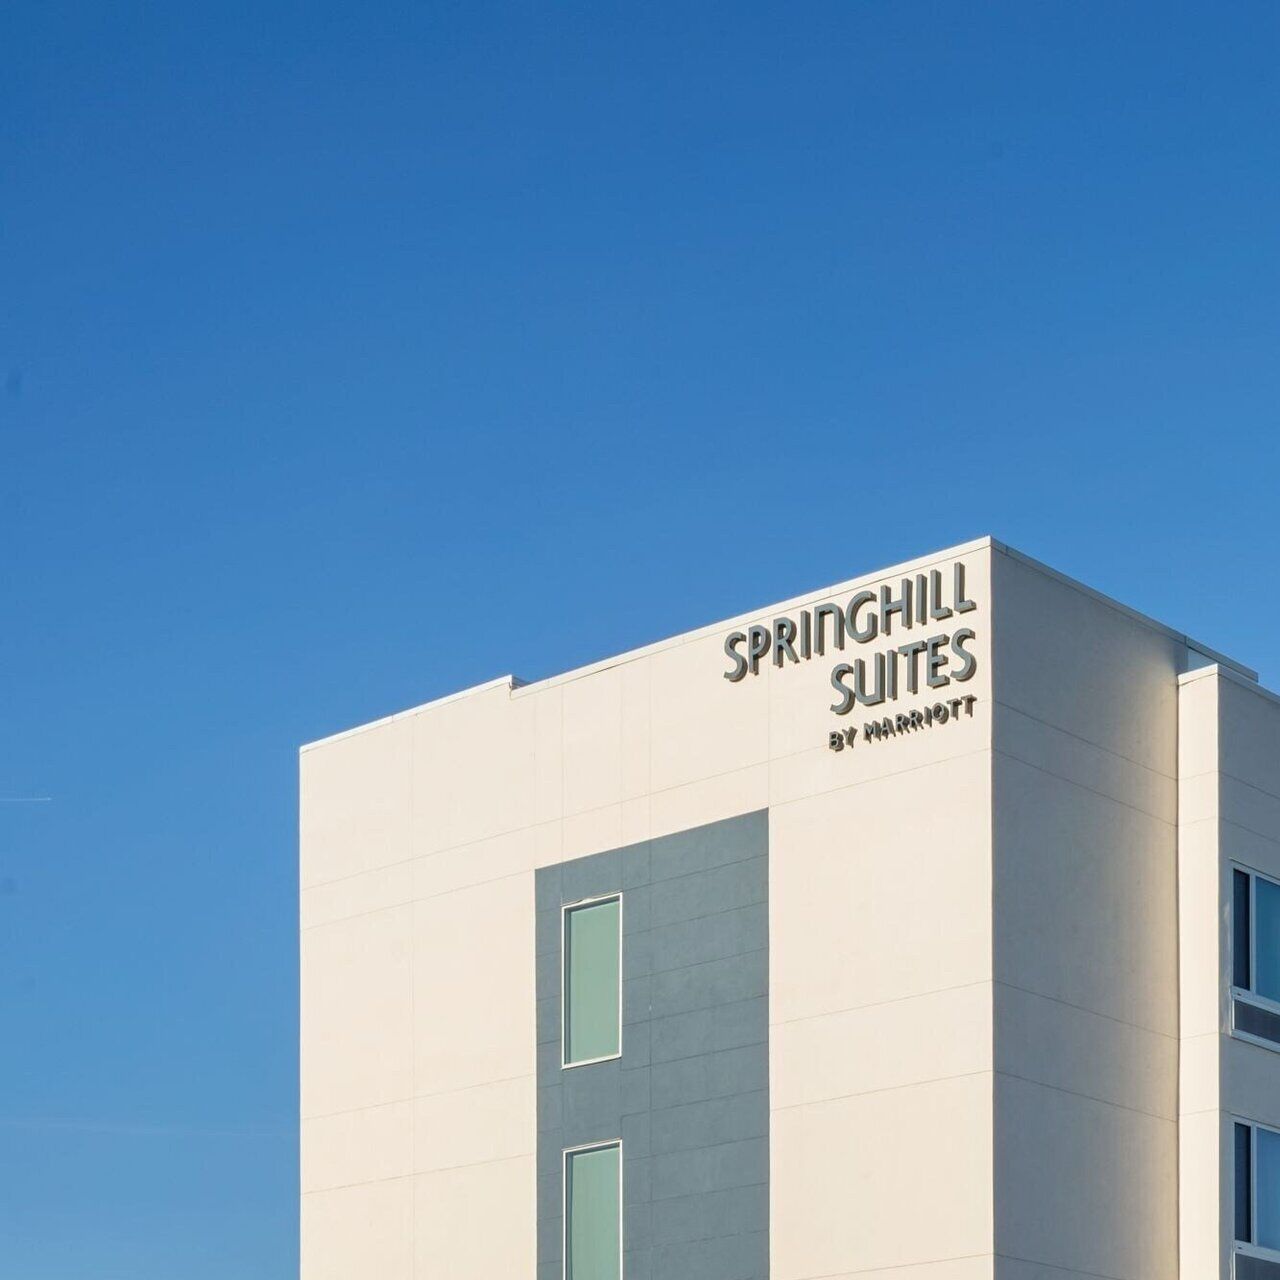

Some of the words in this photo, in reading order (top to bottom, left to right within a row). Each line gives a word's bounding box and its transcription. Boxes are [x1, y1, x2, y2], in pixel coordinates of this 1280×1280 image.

[723, 561, 977, 682] SPRINGHILL
[830, 627, 978, 715] SUITES
[828, 726, 859, 752] BY
[863, 694, 978, 744] MARRIOTT
